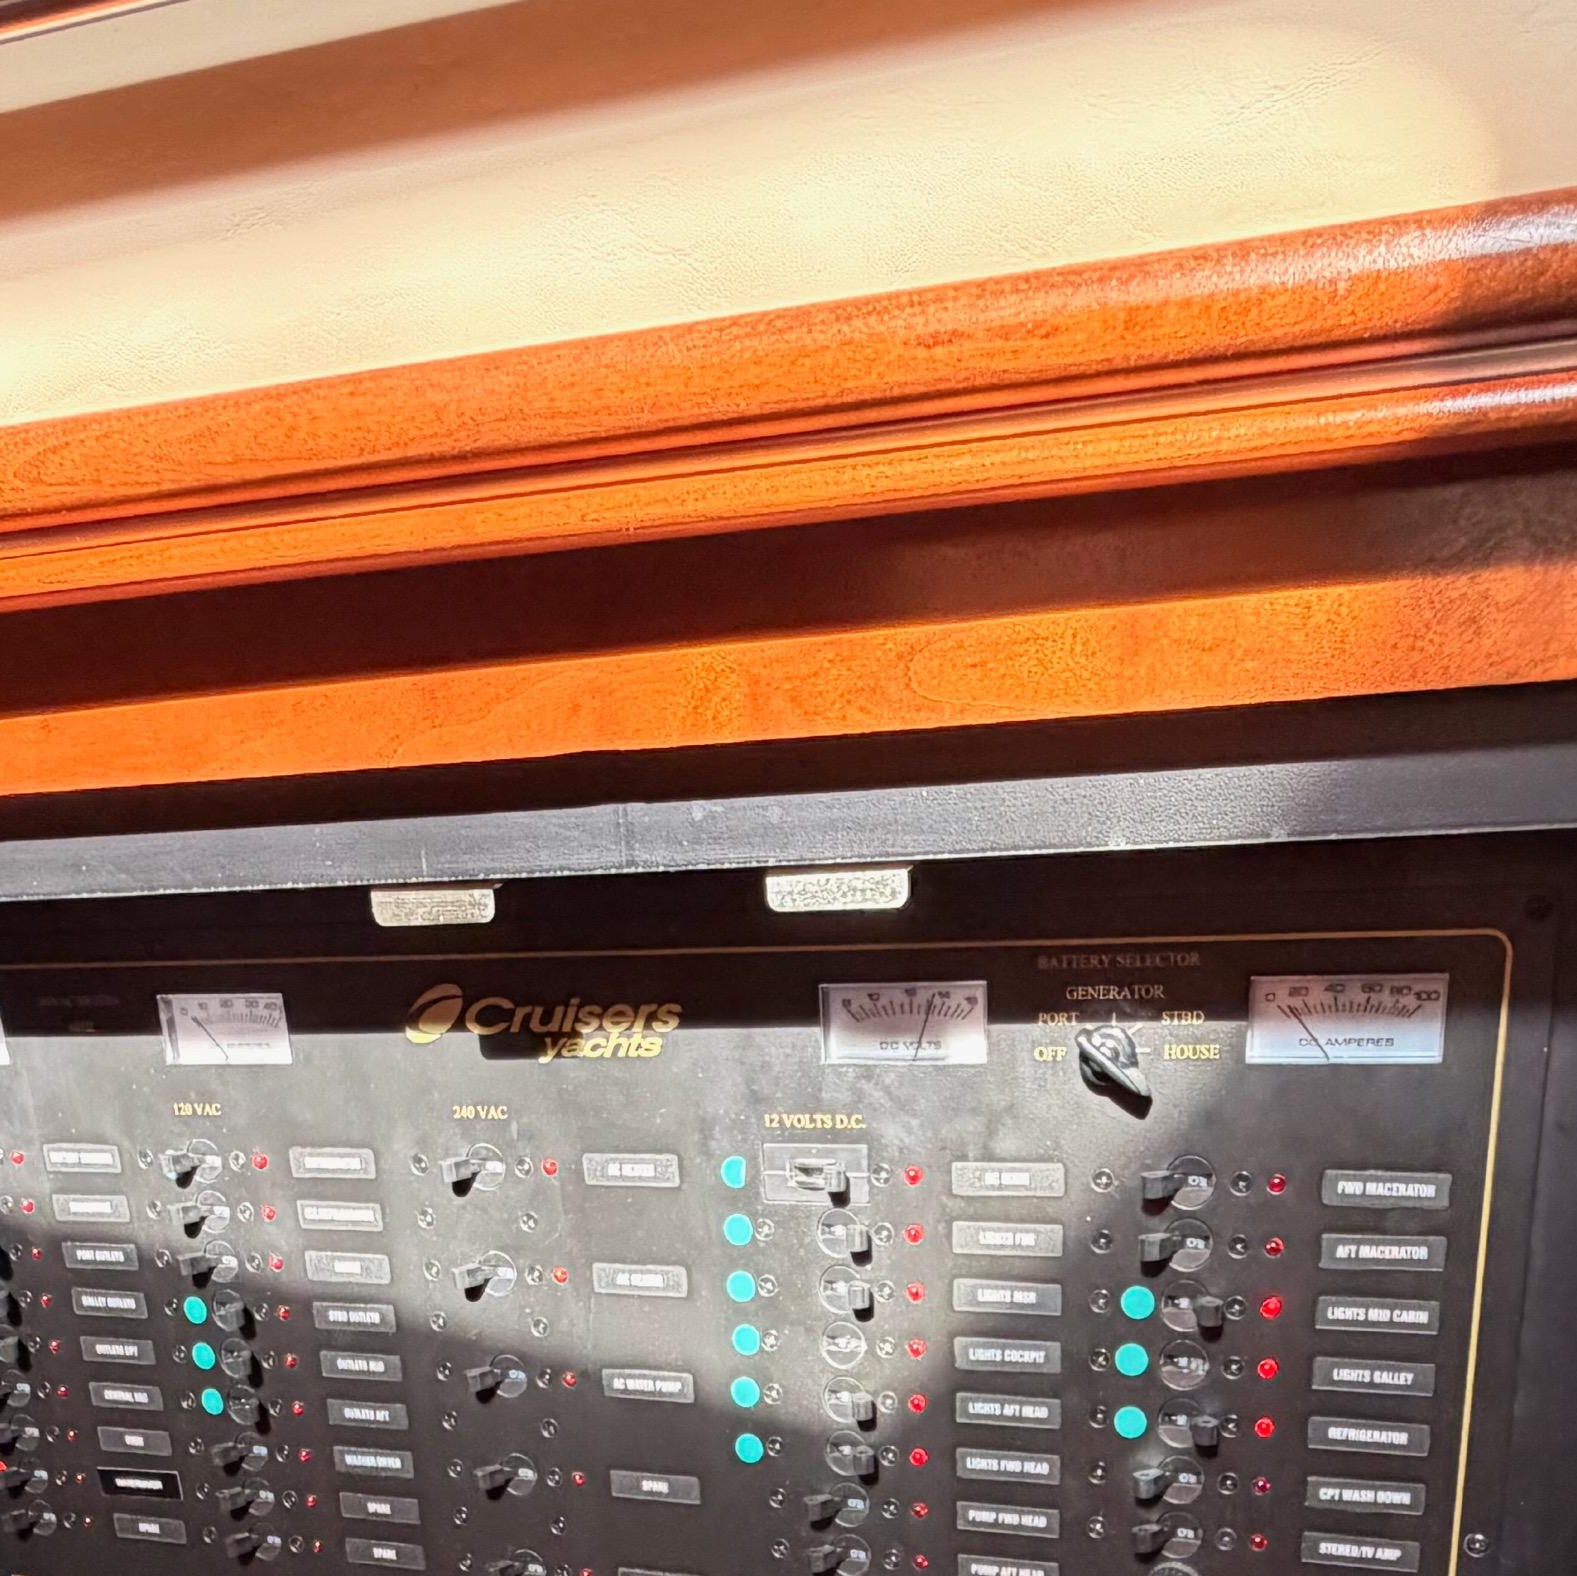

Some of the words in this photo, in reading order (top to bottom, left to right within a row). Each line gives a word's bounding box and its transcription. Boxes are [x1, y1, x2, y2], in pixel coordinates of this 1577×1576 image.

[1037, 953, 1112, 970] BATTERY
[1115, 951, 1200, 968] SELECTOR
[1065, 984, 1165, 1000] GENERATOR
[465, 998, 684, 1036] Cruisers
[1037, 1011, 1080, 1026] PORT
[1161, 1010, 1206, 1026] STBD
[538, 1032, 664, 1064] yachts
[1034, 1046, 1068, 1062] OFF
[1162, 1043, 1222, 1060] HOUSE
[764, 1113, 782, 1128] 12
[780, 1113, 838, 1129] VOLTS
[836, 1113, 866, 1130] D.C.
[1337, 1180, 1364, 1195] FWD
[1365, 1181, 1436, 1197] MACERATOR
[1335, 1244, 1357, 1258] AFT
[1358, 1244, 1428, 1259] MACERATOR
[1327, 1306, 1366, 1321] LIGHTS
[1367, 1307, 1391, 1322] MID
[1392, 1309, 1429, 1323] CABIN
[968, 1347, 1002, 1361] LIGHTS
[1003, 1348, 1046, 1363] COCKPIT
[1332, 1368, 1371, 1382] LIGHTS
[1372, 1370, 1414, 1385] GALLEY
[968, 1401, 1001, 1415] LIGHTS
[1002, 1403, 1020, 1416] AFT
[1021, 1405, 1048, 1418] HEAD
[1327, 1426, 1408, 1445] REFRIGERATOR
[966, 1456, 999, 1471] LIGHTS
[999, 1459, 1022, 1472] FWD
[1023, 1461, 1049, 1475] HEAD
[1318, 1487, 1341, 1500] CPT
[1341, 1488, 1375, 1502] WASH
[1376, 1490, 1411, 1504] DOWN
[967, 1509, 997, 1523] PUMP
[997, 1512, 1020, 1525] FWD
[1020, 1514, 1047, 1528] HEAD
[970, 1563, 1000, 1576] PUMP
